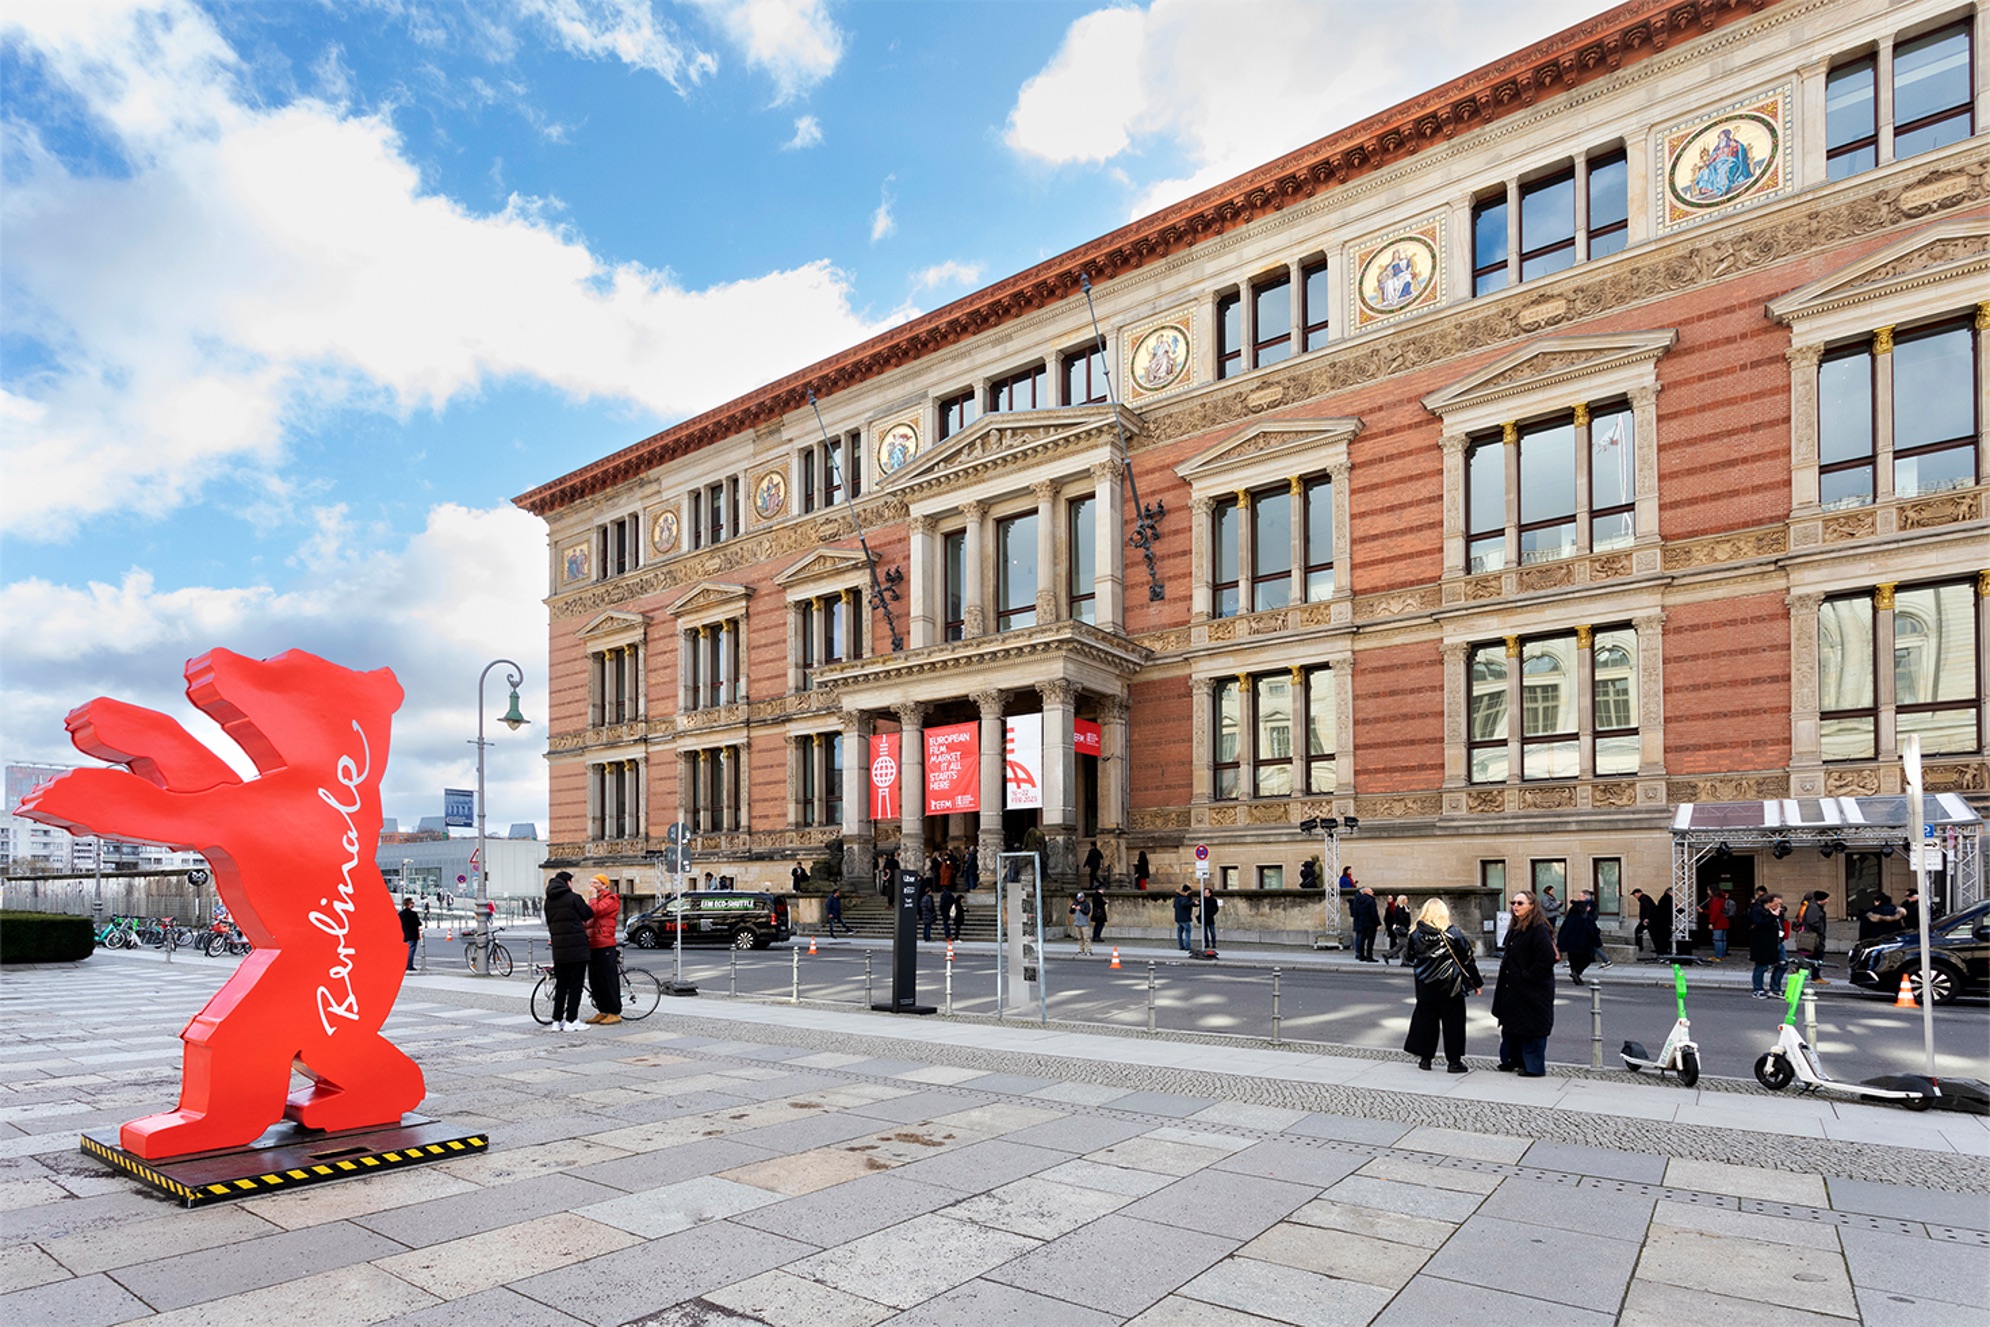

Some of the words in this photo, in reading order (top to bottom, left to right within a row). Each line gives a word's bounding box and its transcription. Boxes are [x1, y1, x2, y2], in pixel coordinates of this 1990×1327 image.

[1901, 180, 1965, 206] SCHINKEL
[929, 732, 970, 746] EUROPEAN
[929, 745, 947, 755] FILM
[929, 752, 961, 764] MARKET
[940, 763, 948, 771] IT
[949, 761, 962, 770] ALL
[929, 771, 957, 781] STARTS
[929, 780, 950, 790] HERE
[936, 800, 953, 809] EFM
[308, 719, 371, 1037] Berlinale
[903, 874, 915, 882] Uber
